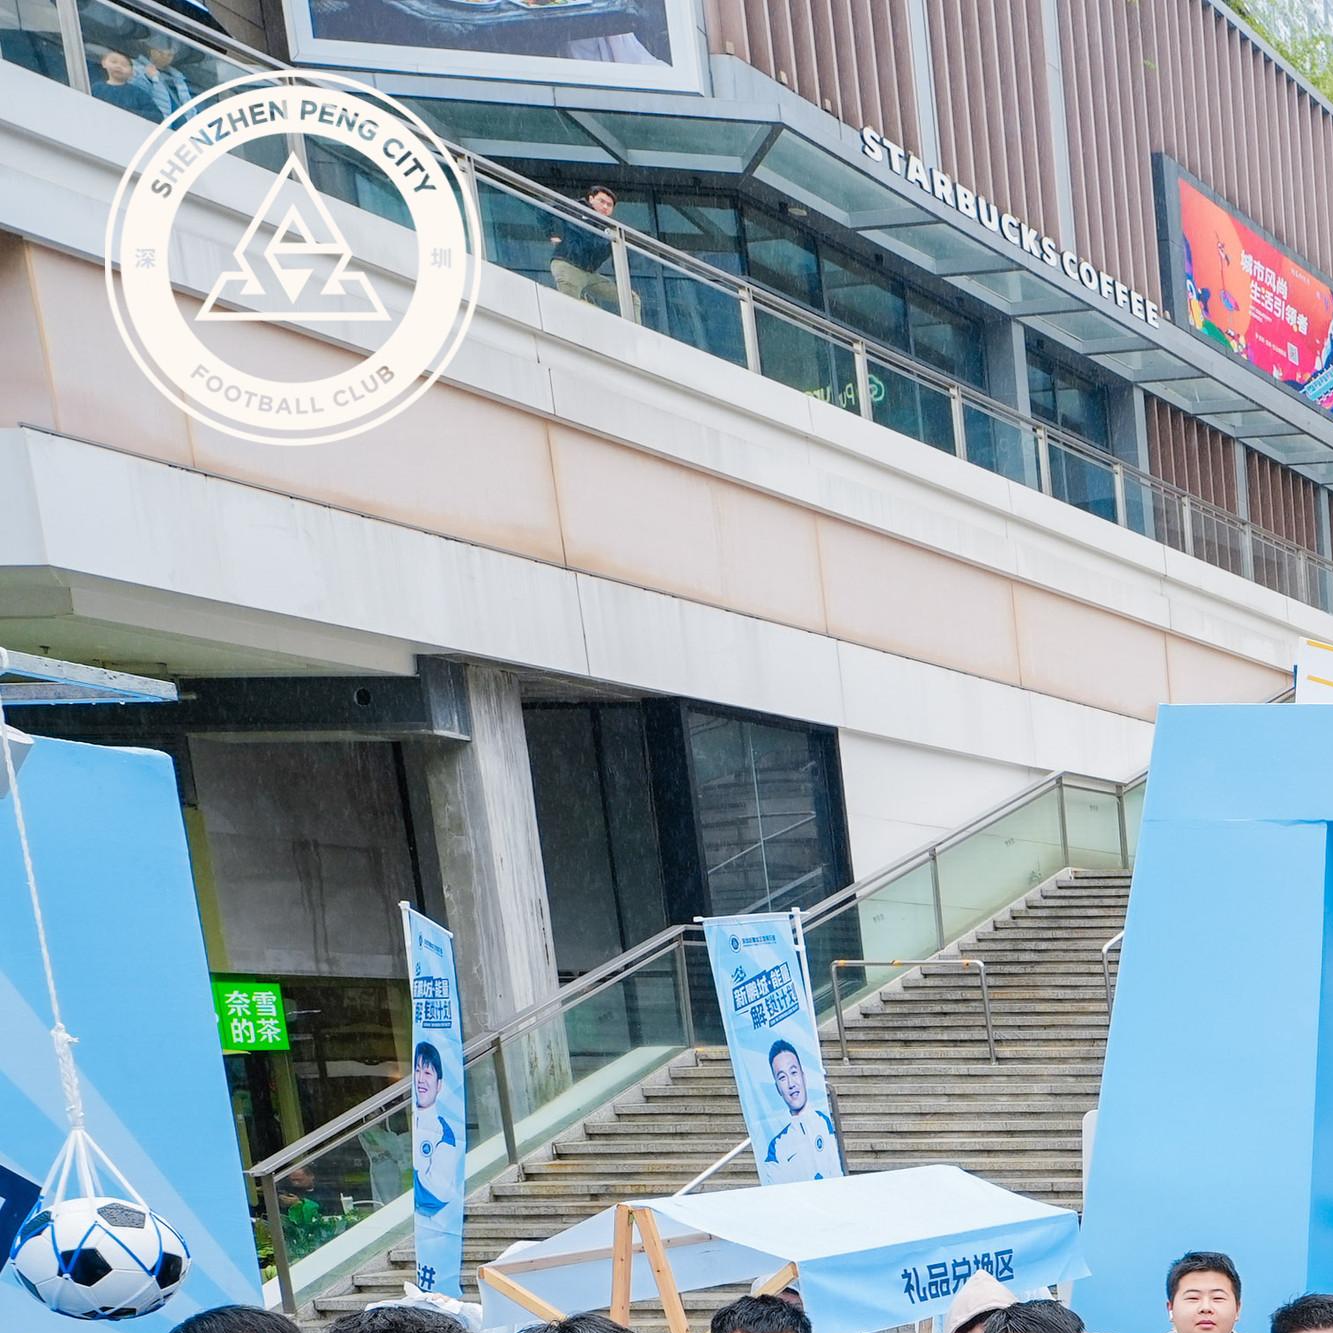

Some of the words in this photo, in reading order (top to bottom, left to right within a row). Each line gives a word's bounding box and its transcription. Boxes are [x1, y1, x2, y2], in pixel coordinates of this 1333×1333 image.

[861, 127, 1057, 267] STARBUCKS
[1060, 250, 1160, 329] COFFEE
[225, 989, 278, 1021] 奈雪
[230, 1017, 283, 1044] 的茶
